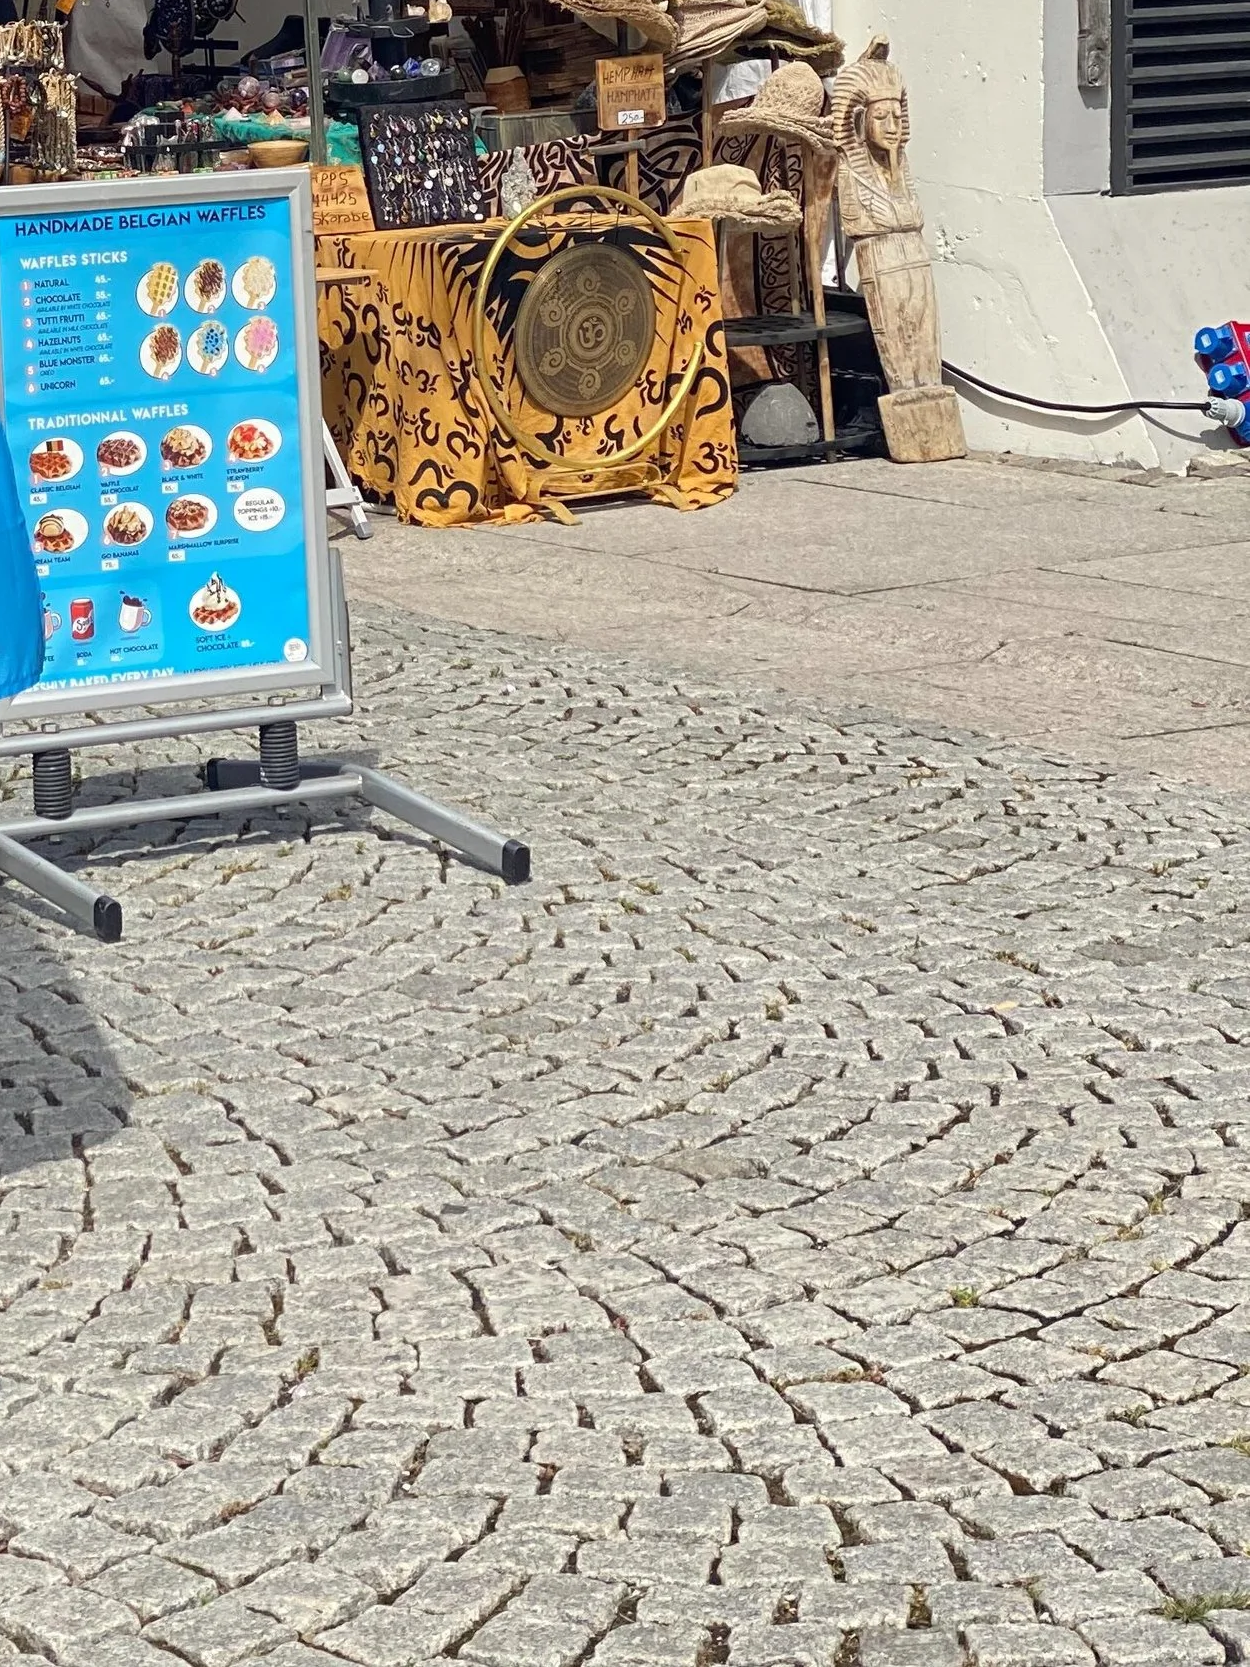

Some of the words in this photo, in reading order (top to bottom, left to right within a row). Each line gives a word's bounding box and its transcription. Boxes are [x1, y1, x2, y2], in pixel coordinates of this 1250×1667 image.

[602, 67, 630, 86] HEMP
[15, 216, 114, 237] HANDMADE
[119, 210, 191, 230] BELGIAN
[197, 205, 267, 223] WAFFLES
[20, 254, 77, 270] WAFFLES
[81, 251, 128, 266] STICKS
[34, 278, 70, 288] NATURAL
[35, 293, 81, 304] CHOCOLATE
[36, 316, 58, 326] TUTTI
[59, 314, 85, 324] FRUTTI
[38, 336, 81, 347] HAZELNUTS
[39, 360, 58, 369] BLUE
[59, 355, 95, 366] MONSTER
[40, 380, 76, 391] UNICORN
[28, 410, 127, 431] TRADITIONNAL
[131, 403, 189, 420] WAFFLES
[162, 475, 180, 483] BLACK
[30, 486, 54, 494] CLASSIC
[110, 485, 139, 494] CHOCOLAT
[245, 499, 275, 507] REGULAR
[237, 507, 268, 515] TOPPINGS
[168, 541, 213, 551] MARSHMALLOW
[196, 635, 213, 643] SOFT
[123, 643, 158, 653] CHOCOLATE
[196, 640, 239, 653] CHOCOLATE
